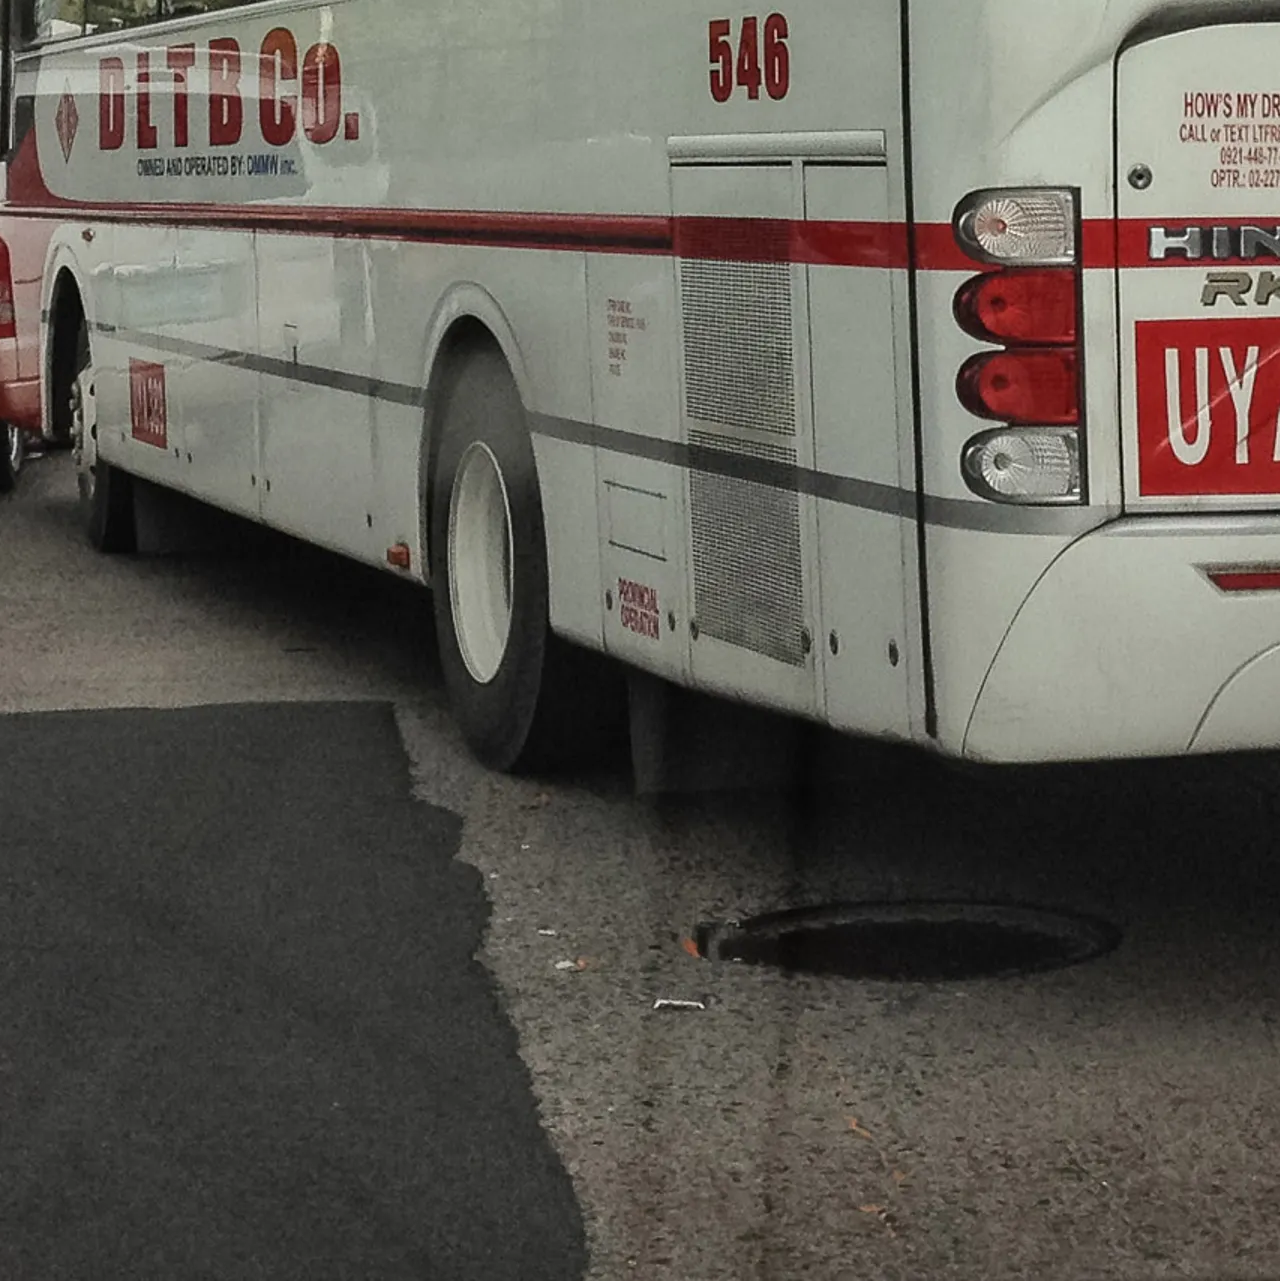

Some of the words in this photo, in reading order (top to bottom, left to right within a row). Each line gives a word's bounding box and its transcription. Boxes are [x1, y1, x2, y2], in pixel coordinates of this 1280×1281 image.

[709, 12, 790, 103] 546
[1184, 92, 1233, 119] HOW'S
[1236, 93, 1258, 118] MY
[1179, 124, 1207, 142] CALL
[1223, 124, 1250, 142] TEXT
[137, 157, 165, 177] OWNED
[166, 157, 183, 176] AND
[184, 157, 228, 176] OPERATED
